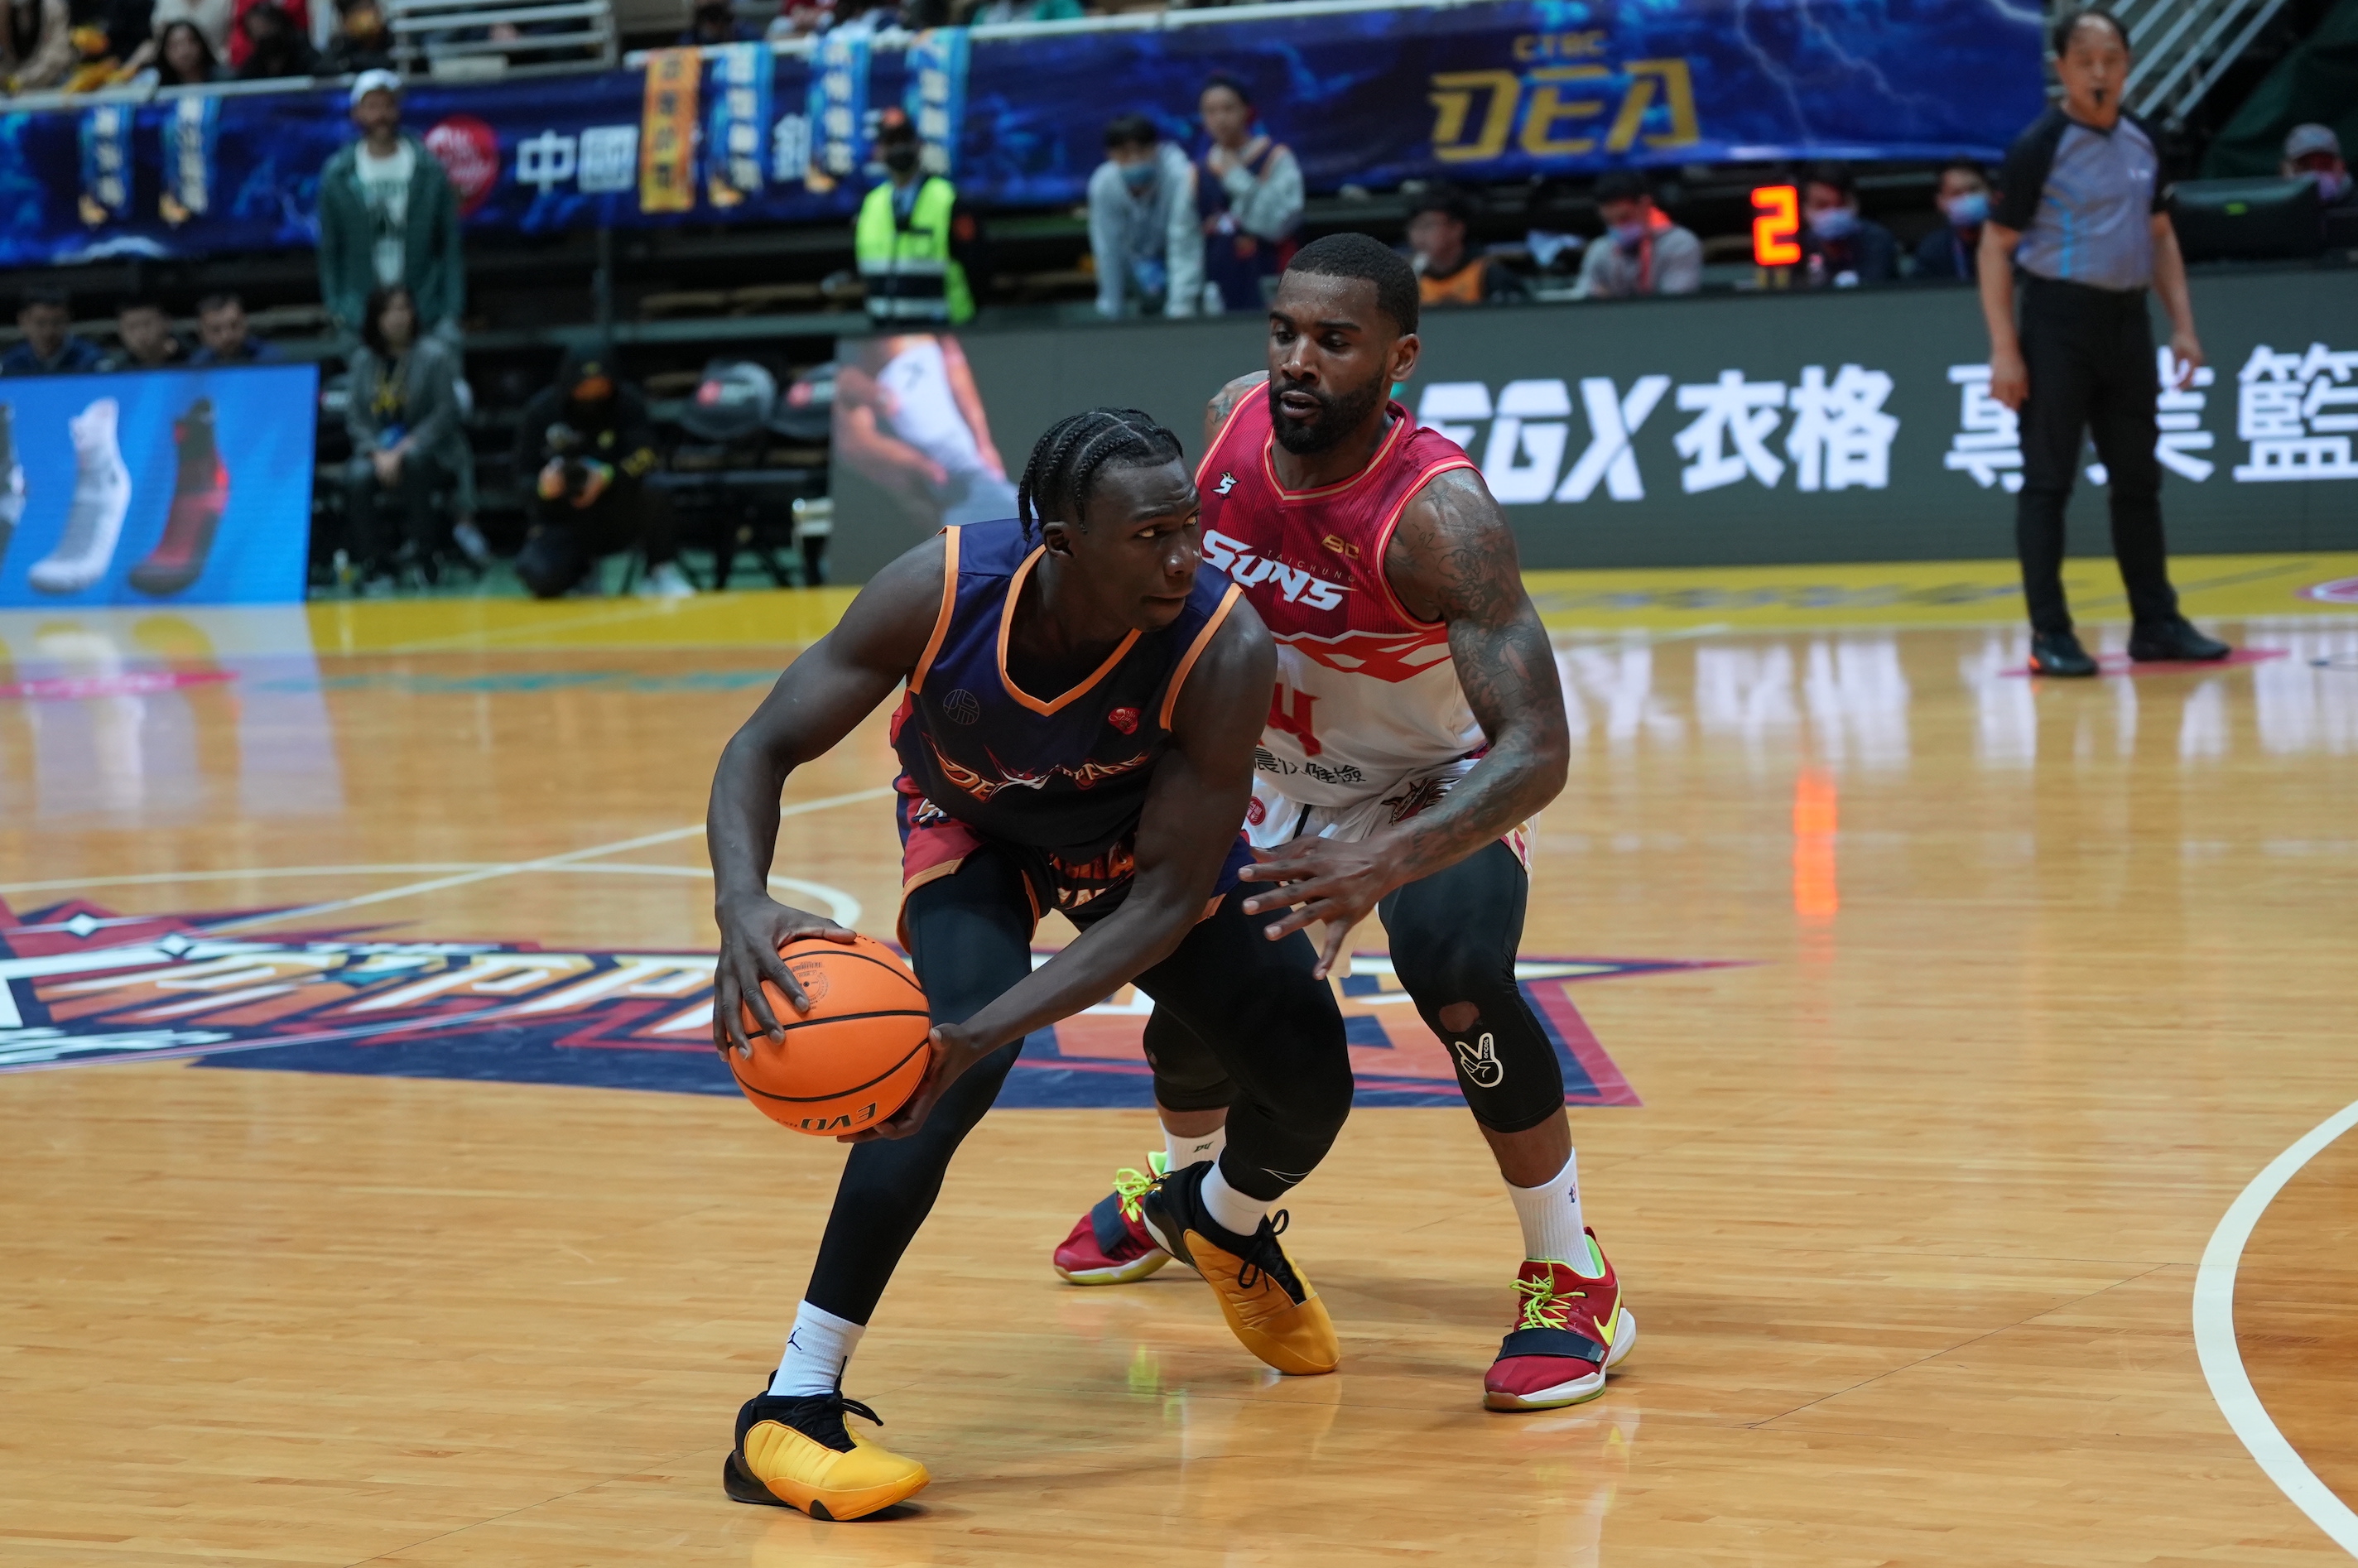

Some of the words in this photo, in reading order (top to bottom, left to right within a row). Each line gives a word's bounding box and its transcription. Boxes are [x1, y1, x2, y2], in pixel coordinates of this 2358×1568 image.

[1427, 57, 1700, 162] DEA
[1750, 185, 1801, 266] 2
[1202, 529, 1359, 611] SUNS
